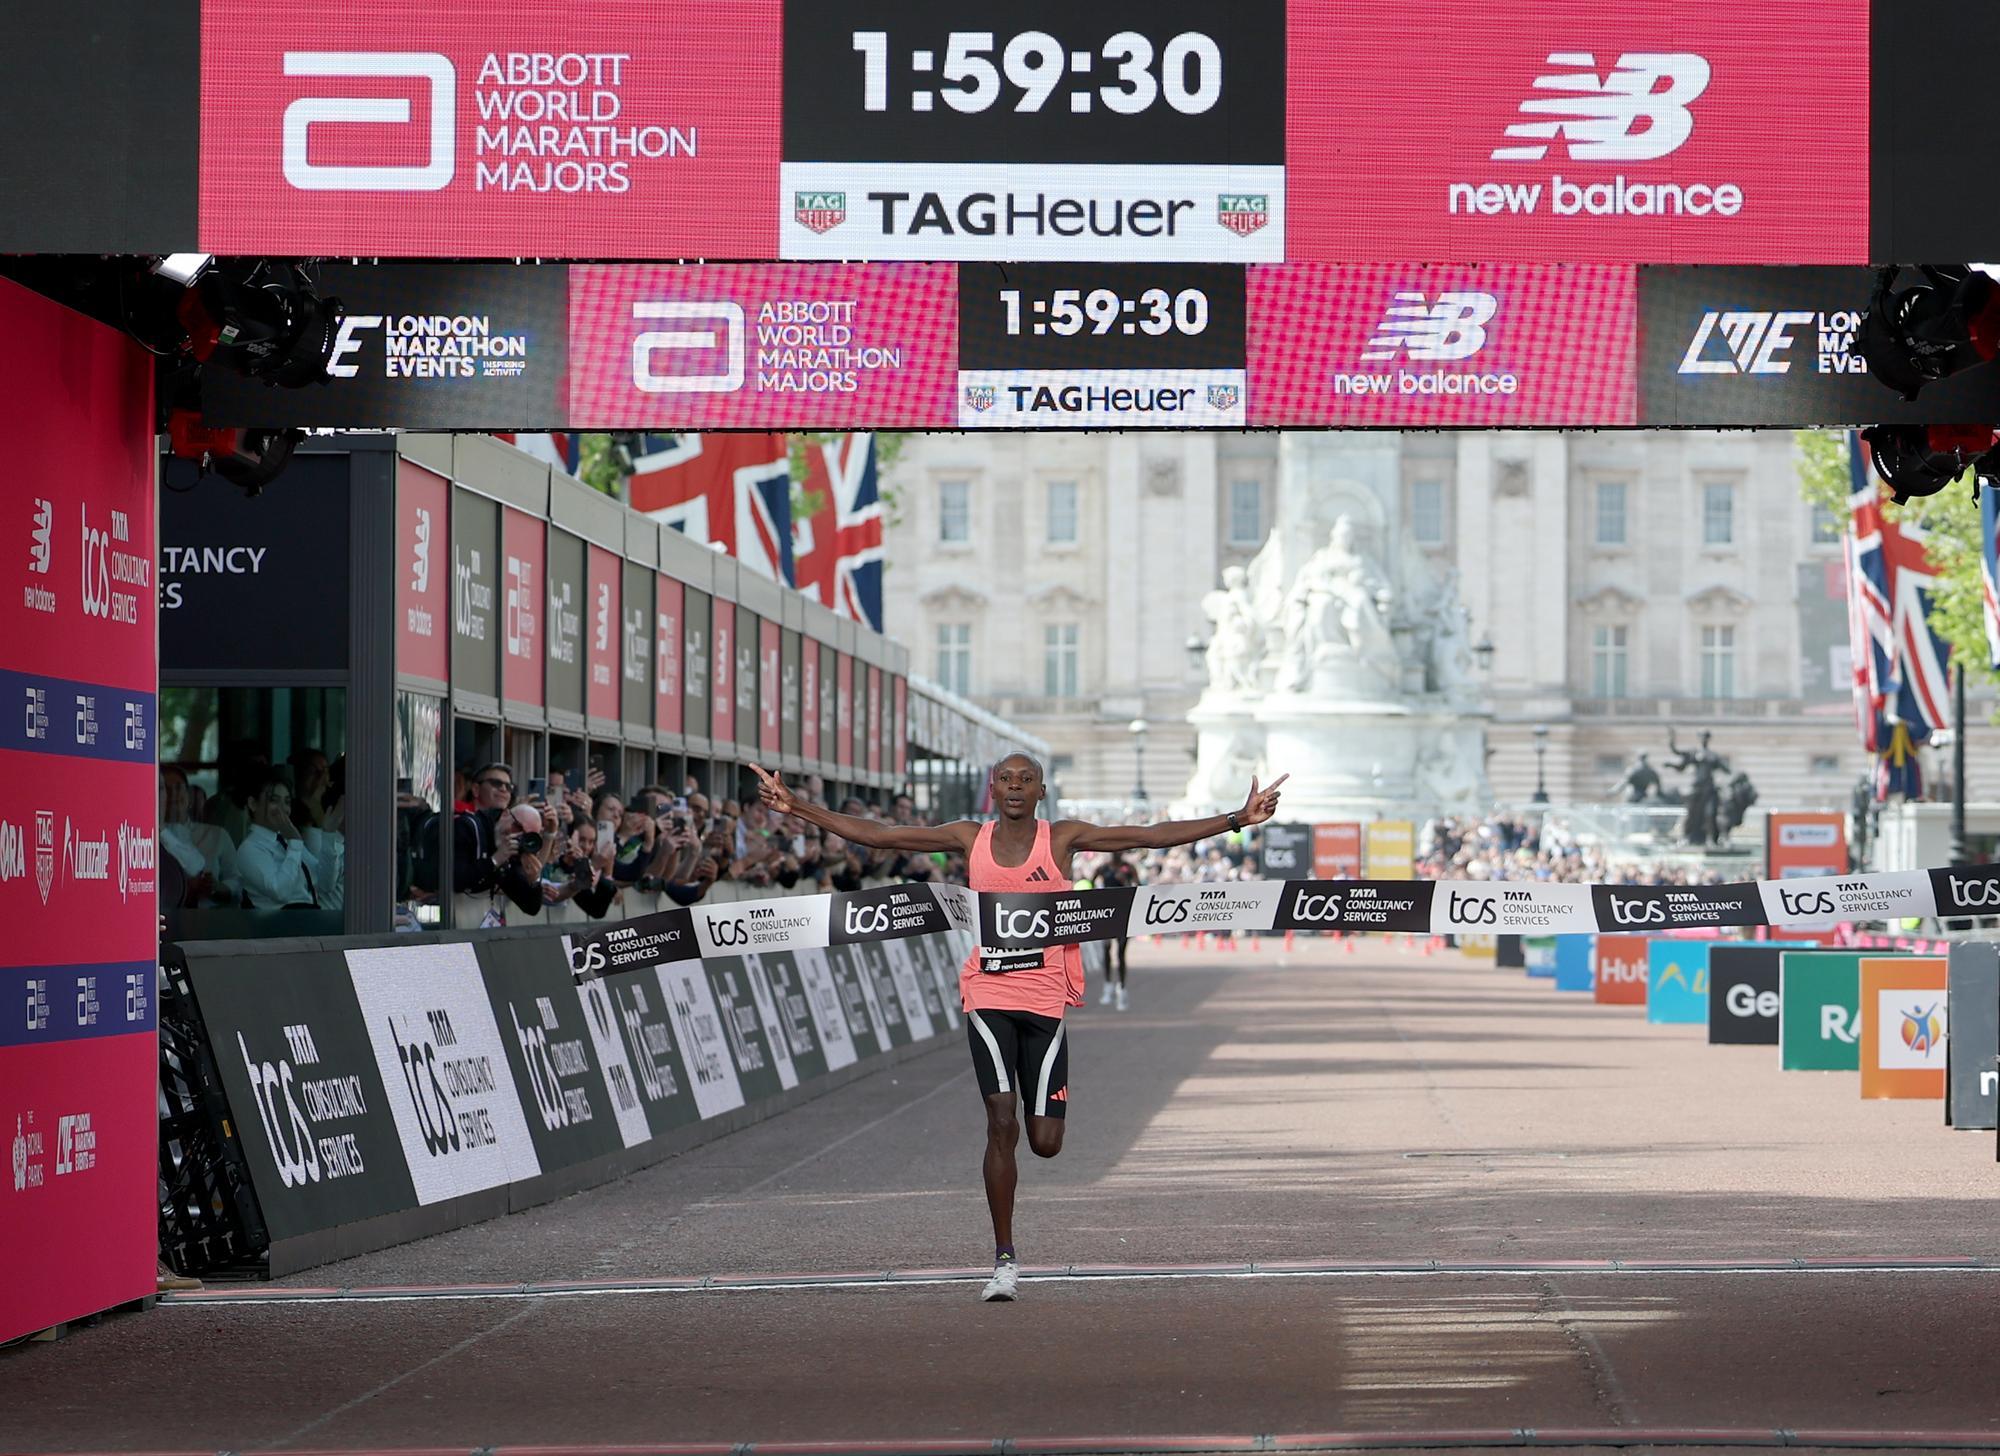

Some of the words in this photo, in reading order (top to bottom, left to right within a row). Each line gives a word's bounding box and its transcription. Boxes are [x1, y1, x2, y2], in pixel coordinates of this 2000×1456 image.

[476, 53, 630, 86] ABBOTT
[853, 31, 1222, 114] 1:59:30
[476, 92, 621, 121] WORLD
[476, 127, 697, 157] MARATHON
[475, 163, 630, 193] MAJORS
[1449, 183, 1541, 215] new
[1553, 176, 1743, 216] balance
[758, 301, 857, 323] ABBOTT
[1000, 288, 1208, 336] 1:59:30
[386, 316, 488, 336] LONDON
[758, 326, 852, 346] WORLD
[386, 337, 525, 356] MARATHON
[386, 357, 475, 377] EVENTS
[758, 348, 900, 369] MARATHON
[757, 371, 858, 392] MAJORS
[1335, 374, 1394, 394] new
[1400, 370, 1517, 394] balance
[112, 510, 129, 542] TATA
[82, 501, 110, 618] tcs
[111, 551, 150, 588] CONSULTANCY
[111, 592, 137, 625] SERVICES
[37, 817, 52, 845] TAG
[75, 828, 109, 879] Lucozade
[890, 893, 911, 905] TATA
[1200, 891, 1226, 900] TATA
[1349, 888, 1377, 899] TATA
[1504, 891, 1532, 901] TATA
[1665, 893, 1699, 903] TATA
[1836, 883, 1868, 892] TATA
[1839, 888, 1913, 903] CONSULTANCY
[1949, 874, 2000, 907] tcs
[892, 901, 935, 918] CONSULTANCY
[1055, 899, 1081, 910] TATA
[1145, 893, 1191, 925] tcs
[1195, 900, 1261, 912] CONSULTANCY
[1292, 888, 1341, 922] tcs
[1346, 899, 1414, 911] CONSULTANCY
[1449, 890, 1497, 925] tcs
[1502, 903, 1574, 915] CONSULTANCY
[1609, 893, 1666, 925] tcs
[1669, 900, 1743, 912] CONSULTANCY
[1780, 888, 1835, 916] tcs
[1842, 901, 1890, 914] SERVICES
[749, 909, 775, 919] TATA
[751, 917, 811, 932] CONSULTANCY
[845, 901, 889, 935] tcs
[892, 916, 925, 931] SERVICES
[995, 902, 1050, 939] tcs
[1054, 907, 1116, 925] CONSULTANCY
[1192, 911, 1233, 923] SERVICES
[1343, 911, 1387, 923] SERVICES
[1503, 915, 1549, 926] SERVICES
[1671, 911, 1720, 922] SERVICES
[605, 927, 638, 942] TATA
[707, 915, 748, 947] tcs
[753, 931, 790, 944] SERVICES
[1053, 922, 1092, 937] SERVICES
[608, 930, 681, 954] CONSULTANCY
[611, 947, 660, 966] SERVICES
[1014, 961, 1038, 969] balance
[1726, 983, 1779, 1017] Ge
[427, 1009, 457, 1047] TATA
[283, 1024, 320, 1065] TATA
[444, 1056, 497, 1098] CONSULTANCY
[509, 1001, 569, 1131] tcs
[388, 1016, 460, 1157] tcs
[237, 1031, 320, 1188] tcs
[302, 1075, 367, 1122] CONSULTANCY
[458, 1108, 496, 1149] SERVICES
[319, 1133, 364, 1180] SERVICES
